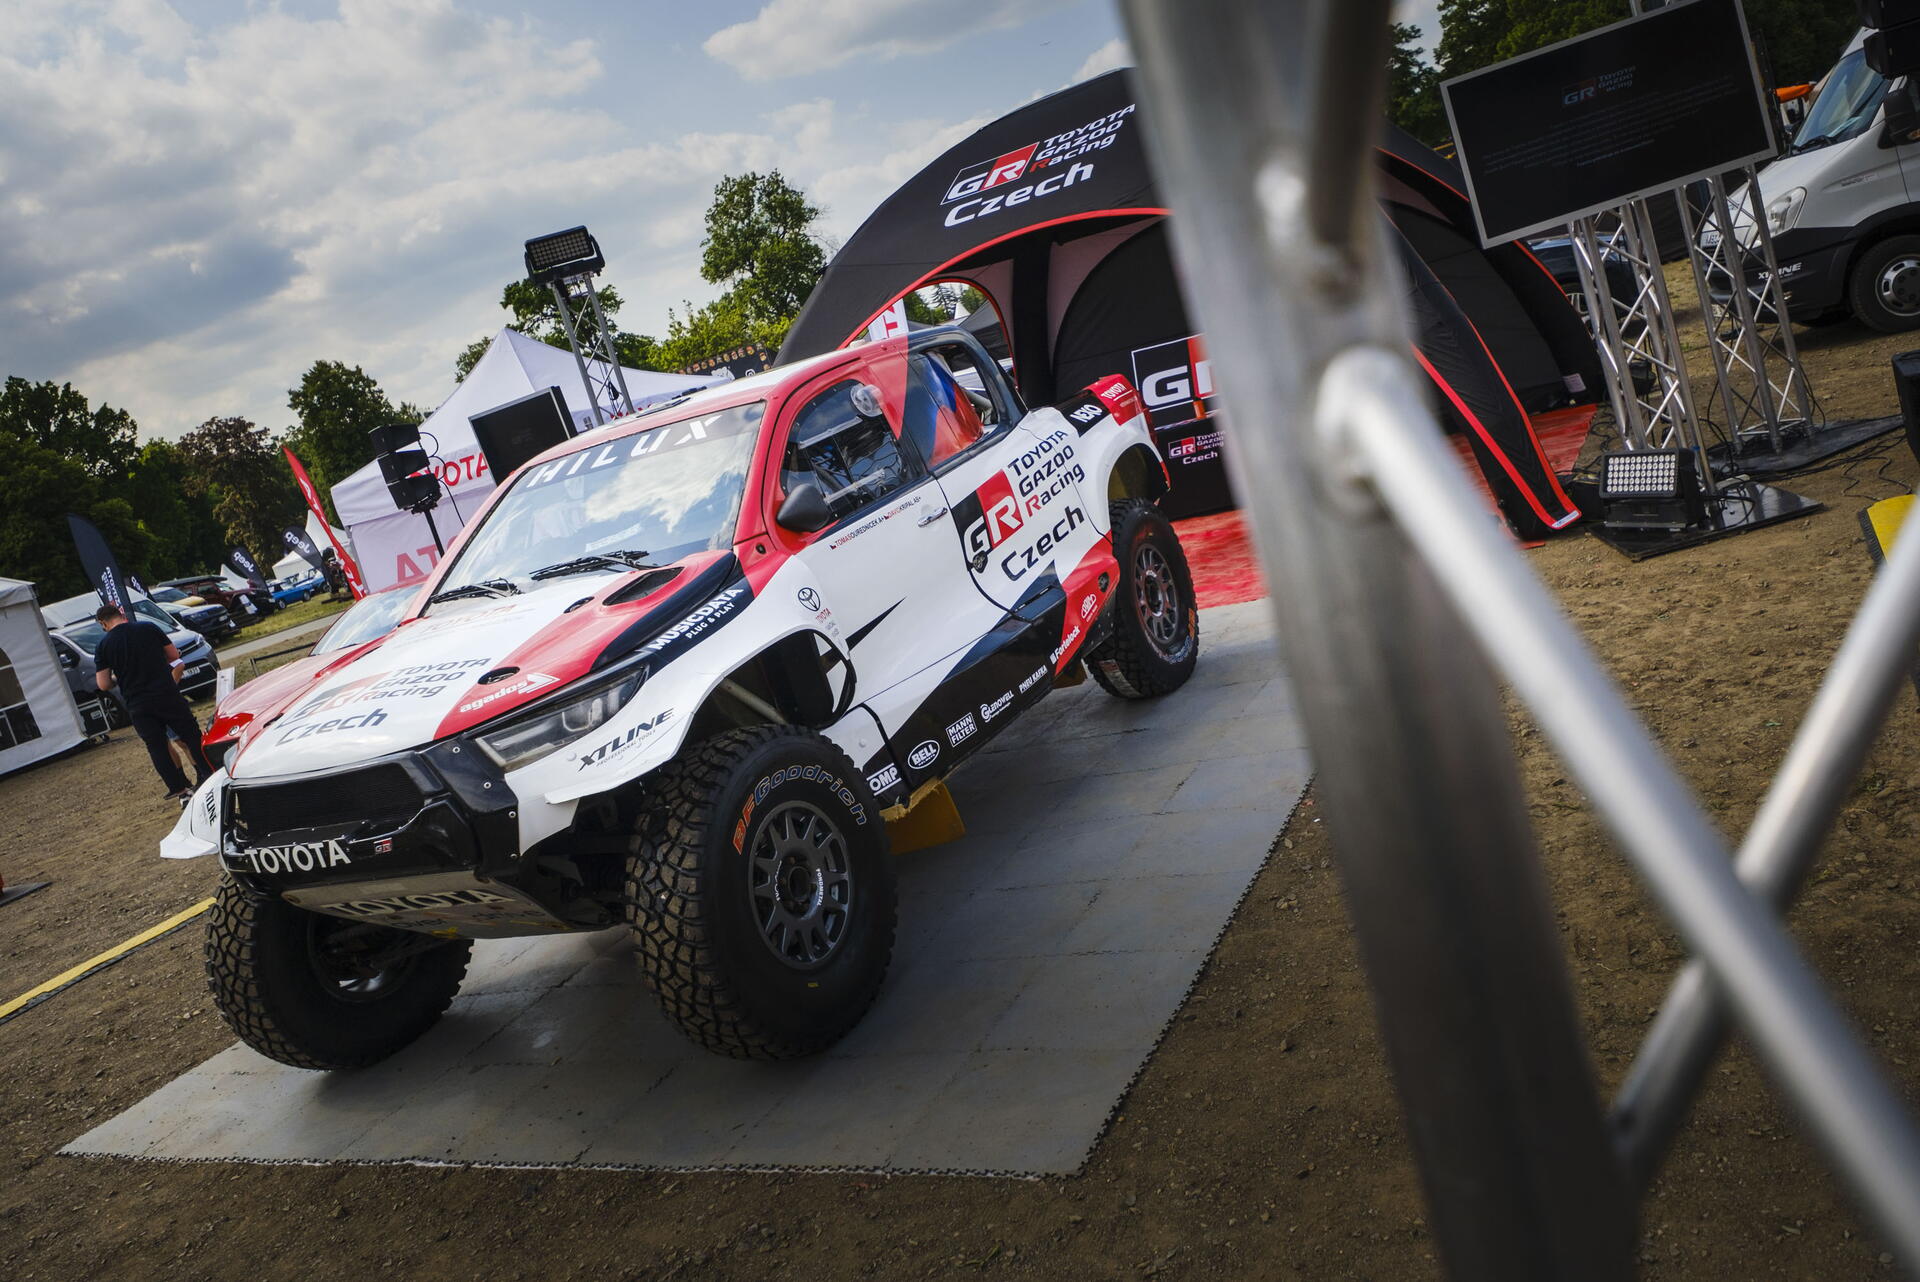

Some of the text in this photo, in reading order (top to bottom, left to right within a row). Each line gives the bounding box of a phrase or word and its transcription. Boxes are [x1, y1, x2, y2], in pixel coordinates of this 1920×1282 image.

[1564, 87, 1594, 105] GR
[1035, 119, 1124, 161] GAZOO
[1044, 103, 1136, 148] TOYOTA
[1029, 133, 1117, 173] Racing
[944, 162, 1095, 227] Czech
[947, 159, 1027, 200] GR
[527, 414, 723, 488] HILUX
[1007, 430, 1069, 477] TOYOTA
[1170, 445, 1195, 457] GR
[1182, 450, 1218, 465] Czech
[1018, 445, 1075, 498] GAZOO
[1025, 463, 1086, 518] Racing
[964, 495, 1022, 564] GR
[1001, 505, 1085, 581] Czech
[647, 588, 745, 650] MUSICDATA
[685, 602, 736, 639] PLUG & PLAY
[1055, 625, 1081, 660] Fortelock
[371, 671, 466, 690] GAZOO
[392, 657, 492, 678] TOYOTA
[1018, 664, 1049, 694] PNEU KAFKA
[353, 684, 447, 704] Racing
[459, 680, 528, 713] agados
[275, 707, 389, 747] Czech
[578, 708, 674, 772] XTLINE
[948, 715, 972, 737] MANN
[951, 723, 975, 745] FILTER
[911, 744, 937, 766] BELL
[869, 766, 898, 791] OMP
[205, 787, 217, 827] XTLINE
[733, 764, 867, 855] BFGoodrich
[244, 839, 352, 874] TOYOTA
[320, 889, 516, 916] TOYOTA
